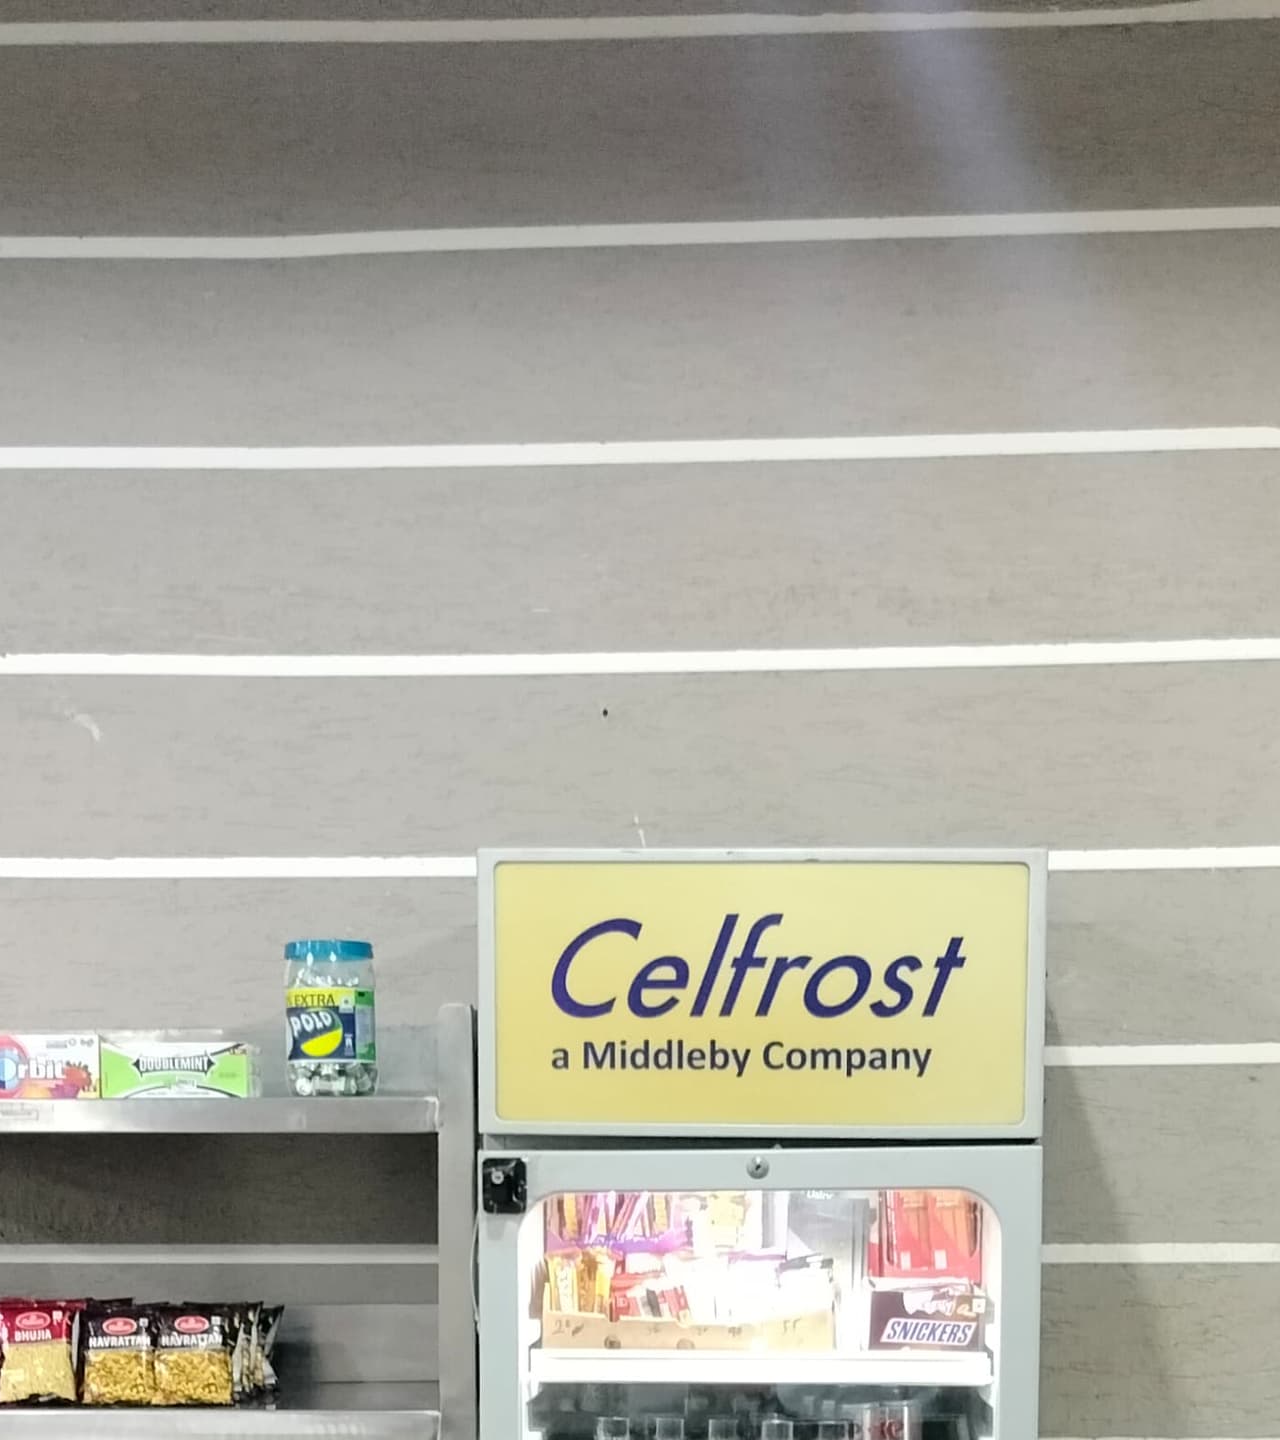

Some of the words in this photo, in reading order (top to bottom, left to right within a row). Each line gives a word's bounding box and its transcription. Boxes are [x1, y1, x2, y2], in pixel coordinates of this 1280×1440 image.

[551, 913, 967, 1018] Celfrost
[294, 993, 336, 1008] EXTRA
[289, 1010, 333, 1039] POLO
[138, 1054, 210, 1074] DOUBLEMINT
[551, 1046, 569, 1070] a
[582, 1040, 751, 1077] Middleby
[762, 1041, 932, 1077] Company
[15, 1329, 52, 1342] BHUJIA
[887, 1319, 973, 1344] SNICKERS
